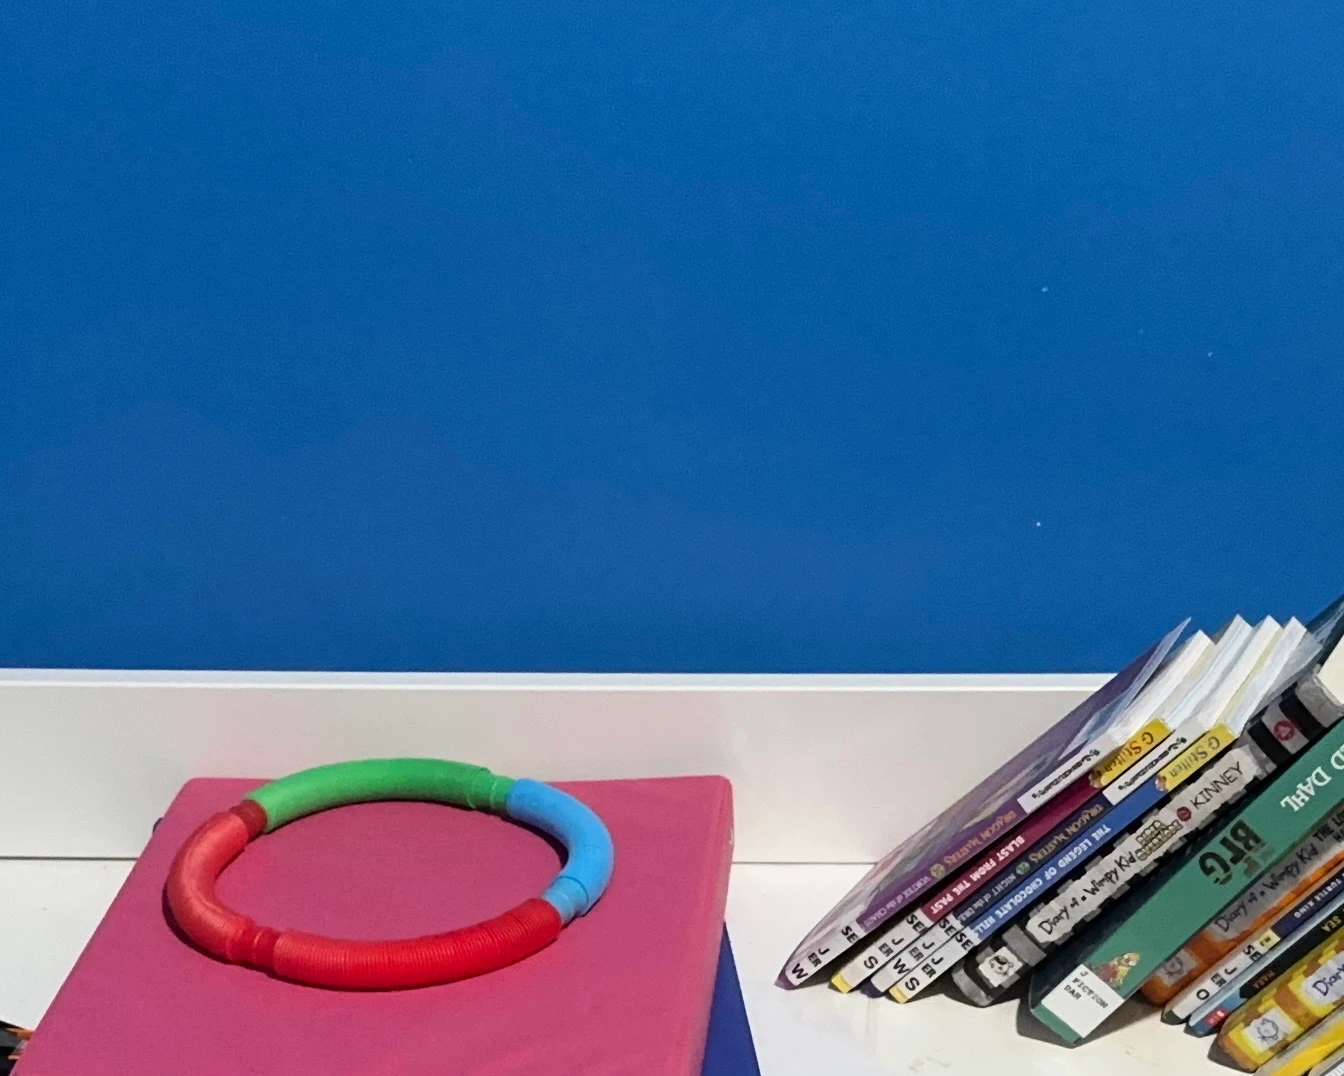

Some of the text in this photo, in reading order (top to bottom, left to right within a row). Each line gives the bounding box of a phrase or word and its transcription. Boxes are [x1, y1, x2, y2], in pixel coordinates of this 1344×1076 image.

[1188, 761, 1247, 810] KINNEY
[1278, 765, 1331, 815] DAHL
[1064, 801, 1104, 837] DRAGON
[942, 808, 1018, 867] DRAGON MASTERS
[1090, 822, 1111, 842] THE
[1312, 820, 1337, 844] THE
[1028, 830, 1067, 865] MASTERS
[1055, 837, 1092, 869] LEGEND
[1195, 818, 1263, 887] BFG
[928, 834, 1026, 914] BLAST FROM THE PAST
[1042, 865, 1058, 880] OF
[900, 873, 932, 900] VORTEX
[989, 871, 1017, 896] NIGHT
[1036, 904, 1074, 938] Diary
[1067, 896, 1081, 910] of
[1083, 865, 1122, 899] Wimpy
[1113, 849, 1137, 872] Kid
[1213, 898, 1252, 933] Diary
[1261, 855, 1304, 895] Wimpy
[1295, 841, 1320, 865] Kid
[1312, 877, 1342, 902] TURTLE
[992, 876, 1044, 918] CHOCOLATE
[1291, 898, 1315, 919] KING
[1319, 914, 1342, 934] SEA
[816, 943, 830, 956] J
[877, 941, 894, 958] ER
[889, 933, 904, 947] J
[920, 937, 935, 951] J
[806, 951, 822, 968] ER
[861, 953, 879, 971] S
[908, 945, 924, 962] ER
[930, 953, 944, 967] J
[789, 962, 809, 982] W
[890, 957, 910, 977] W
[921, 962, 937, 978] ER
[1223, 962, 1238, 977] J
[903, 975, 921, 993] S
[1063, 984, 1082, 1000] DAH
[1069, 976, 1110, 1009] FICTION
